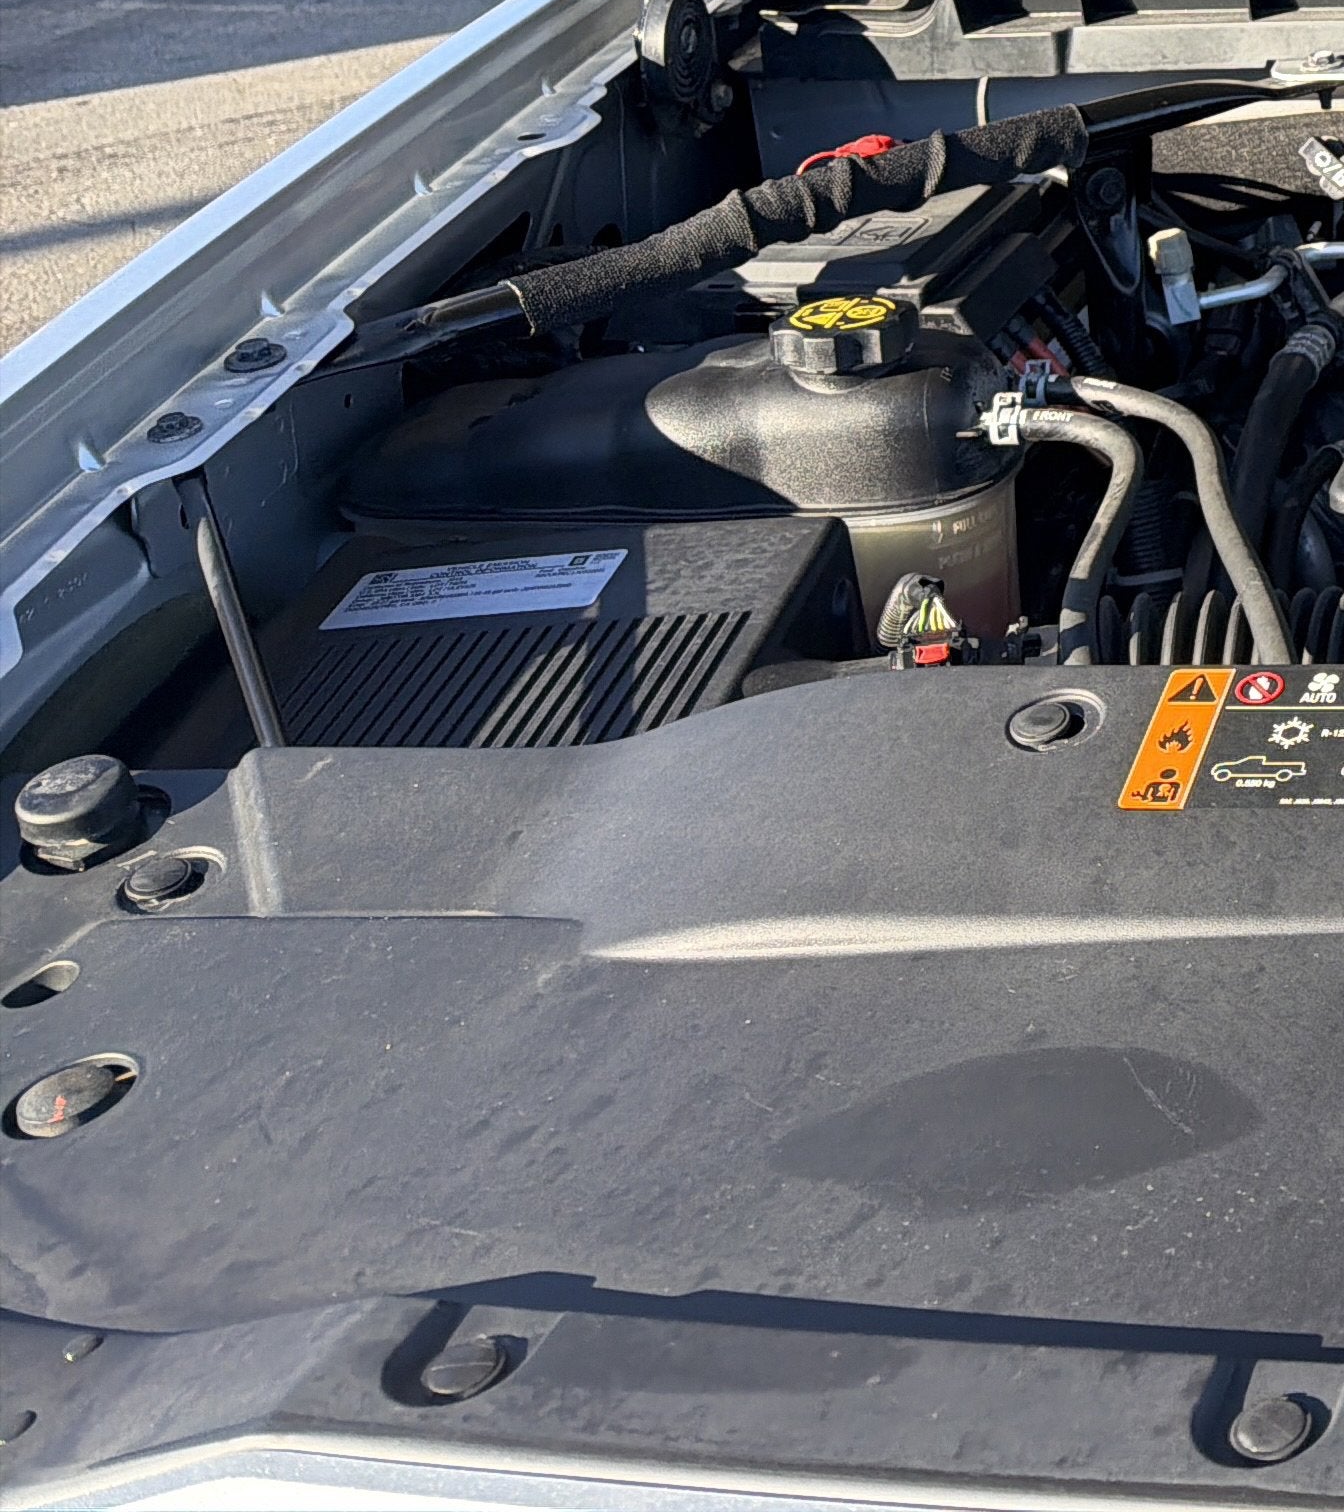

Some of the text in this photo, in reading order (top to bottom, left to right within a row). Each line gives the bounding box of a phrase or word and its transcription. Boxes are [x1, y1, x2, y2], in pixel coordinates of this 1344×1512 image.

[1032, 410, 1074, 422] FRONT
[952, 515, 977, 535] FULL
[1299, 692, 1337, 703] AUTO
